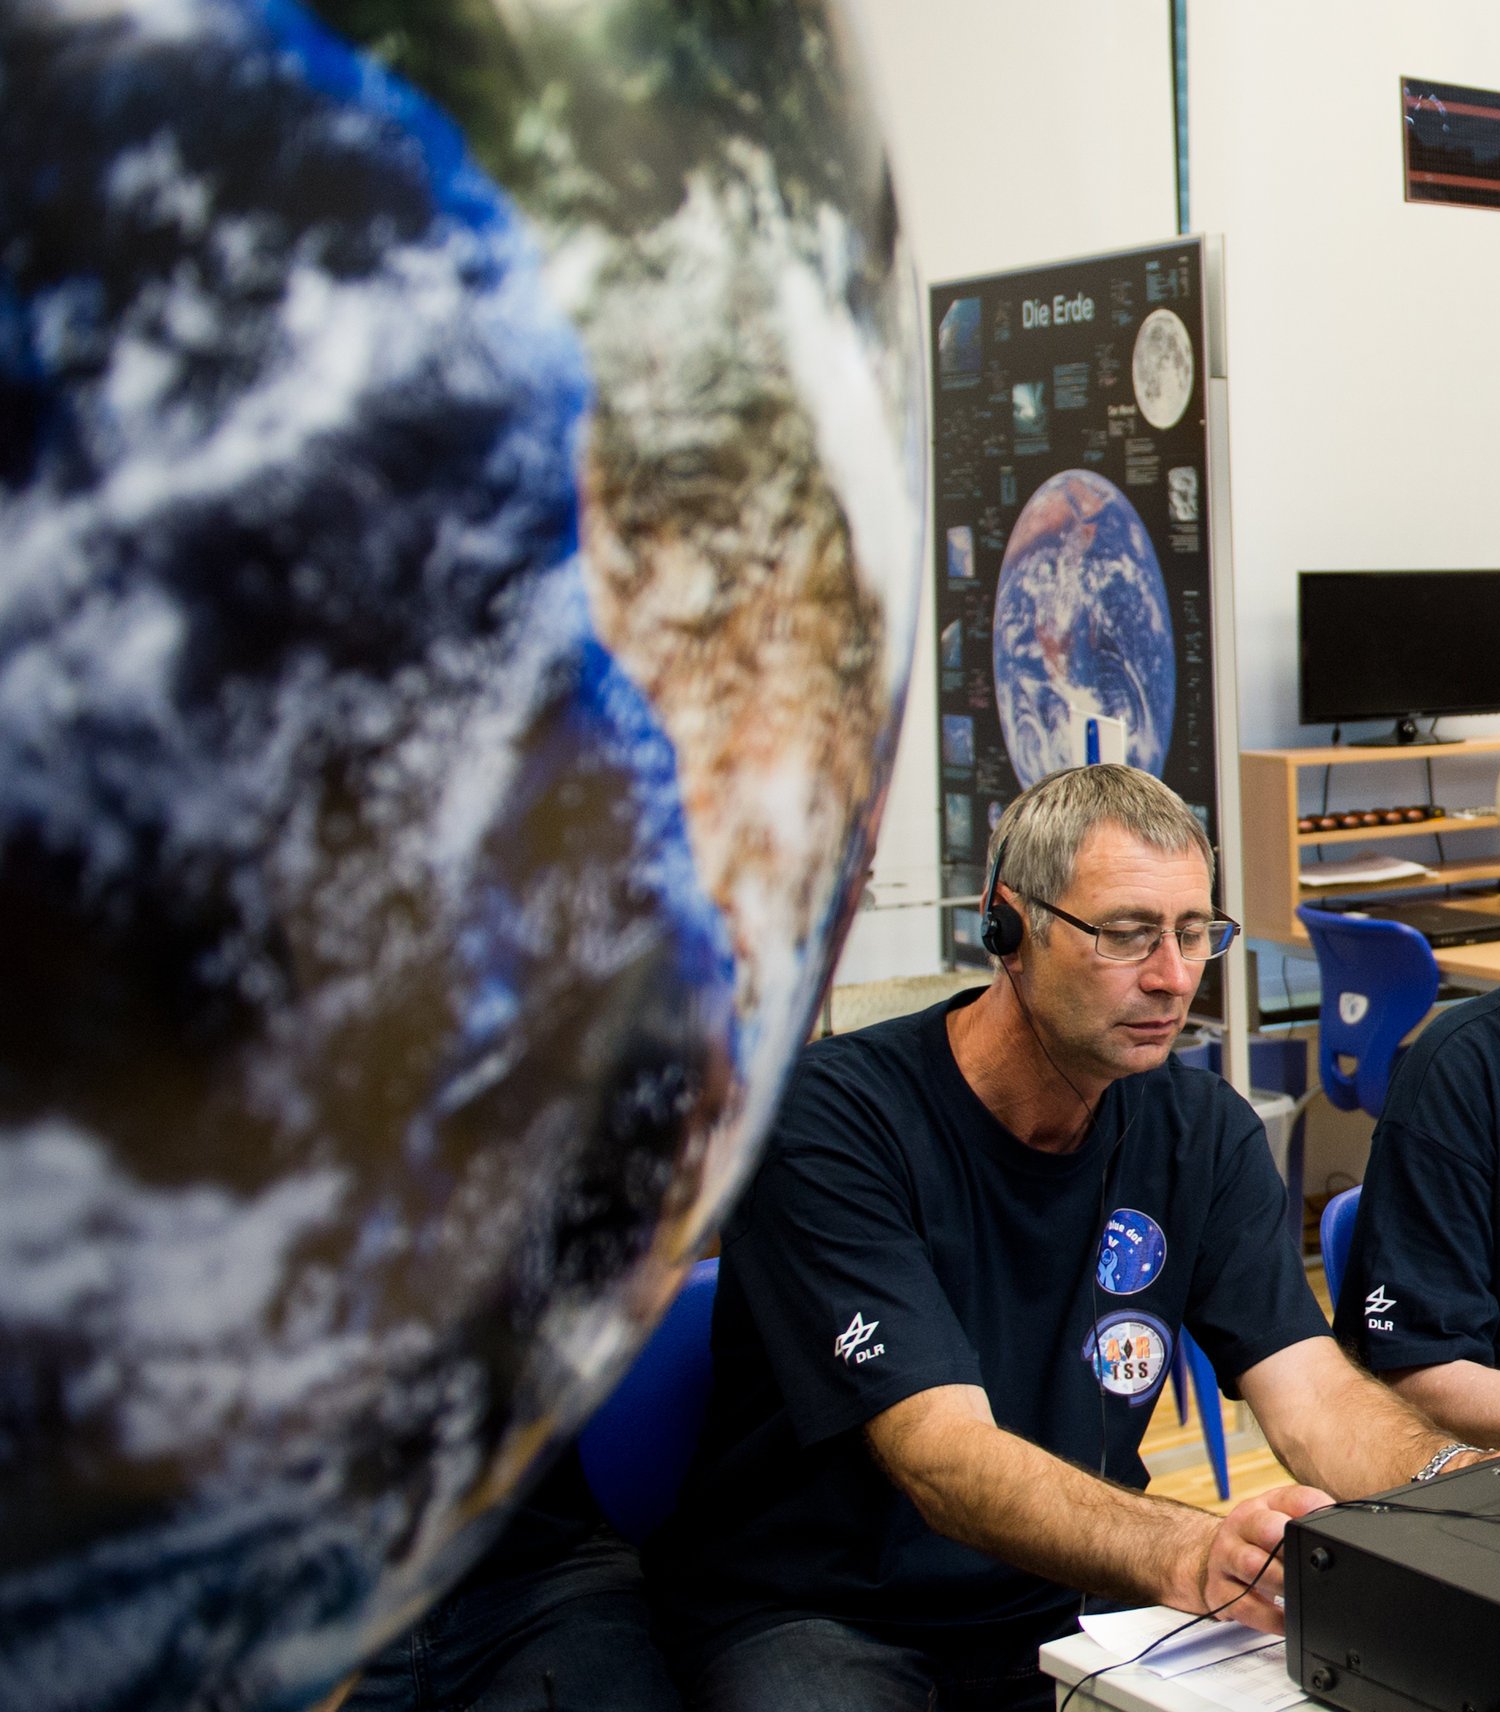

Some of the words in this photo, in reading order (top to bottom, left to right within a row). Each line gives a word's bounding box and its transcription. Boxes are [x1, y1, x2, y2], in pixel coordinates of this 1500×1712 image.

[1022, 299, 1050, 330] Die
[1053, 292, 1095, 324] Erde
[1125, 1228, 1143, 1245] dot
[1368, 1318, 1394, 1332] DLR
[855, 1343, 886, 1364] DLR
[1112, 1361, 1149, 1381] ISS
